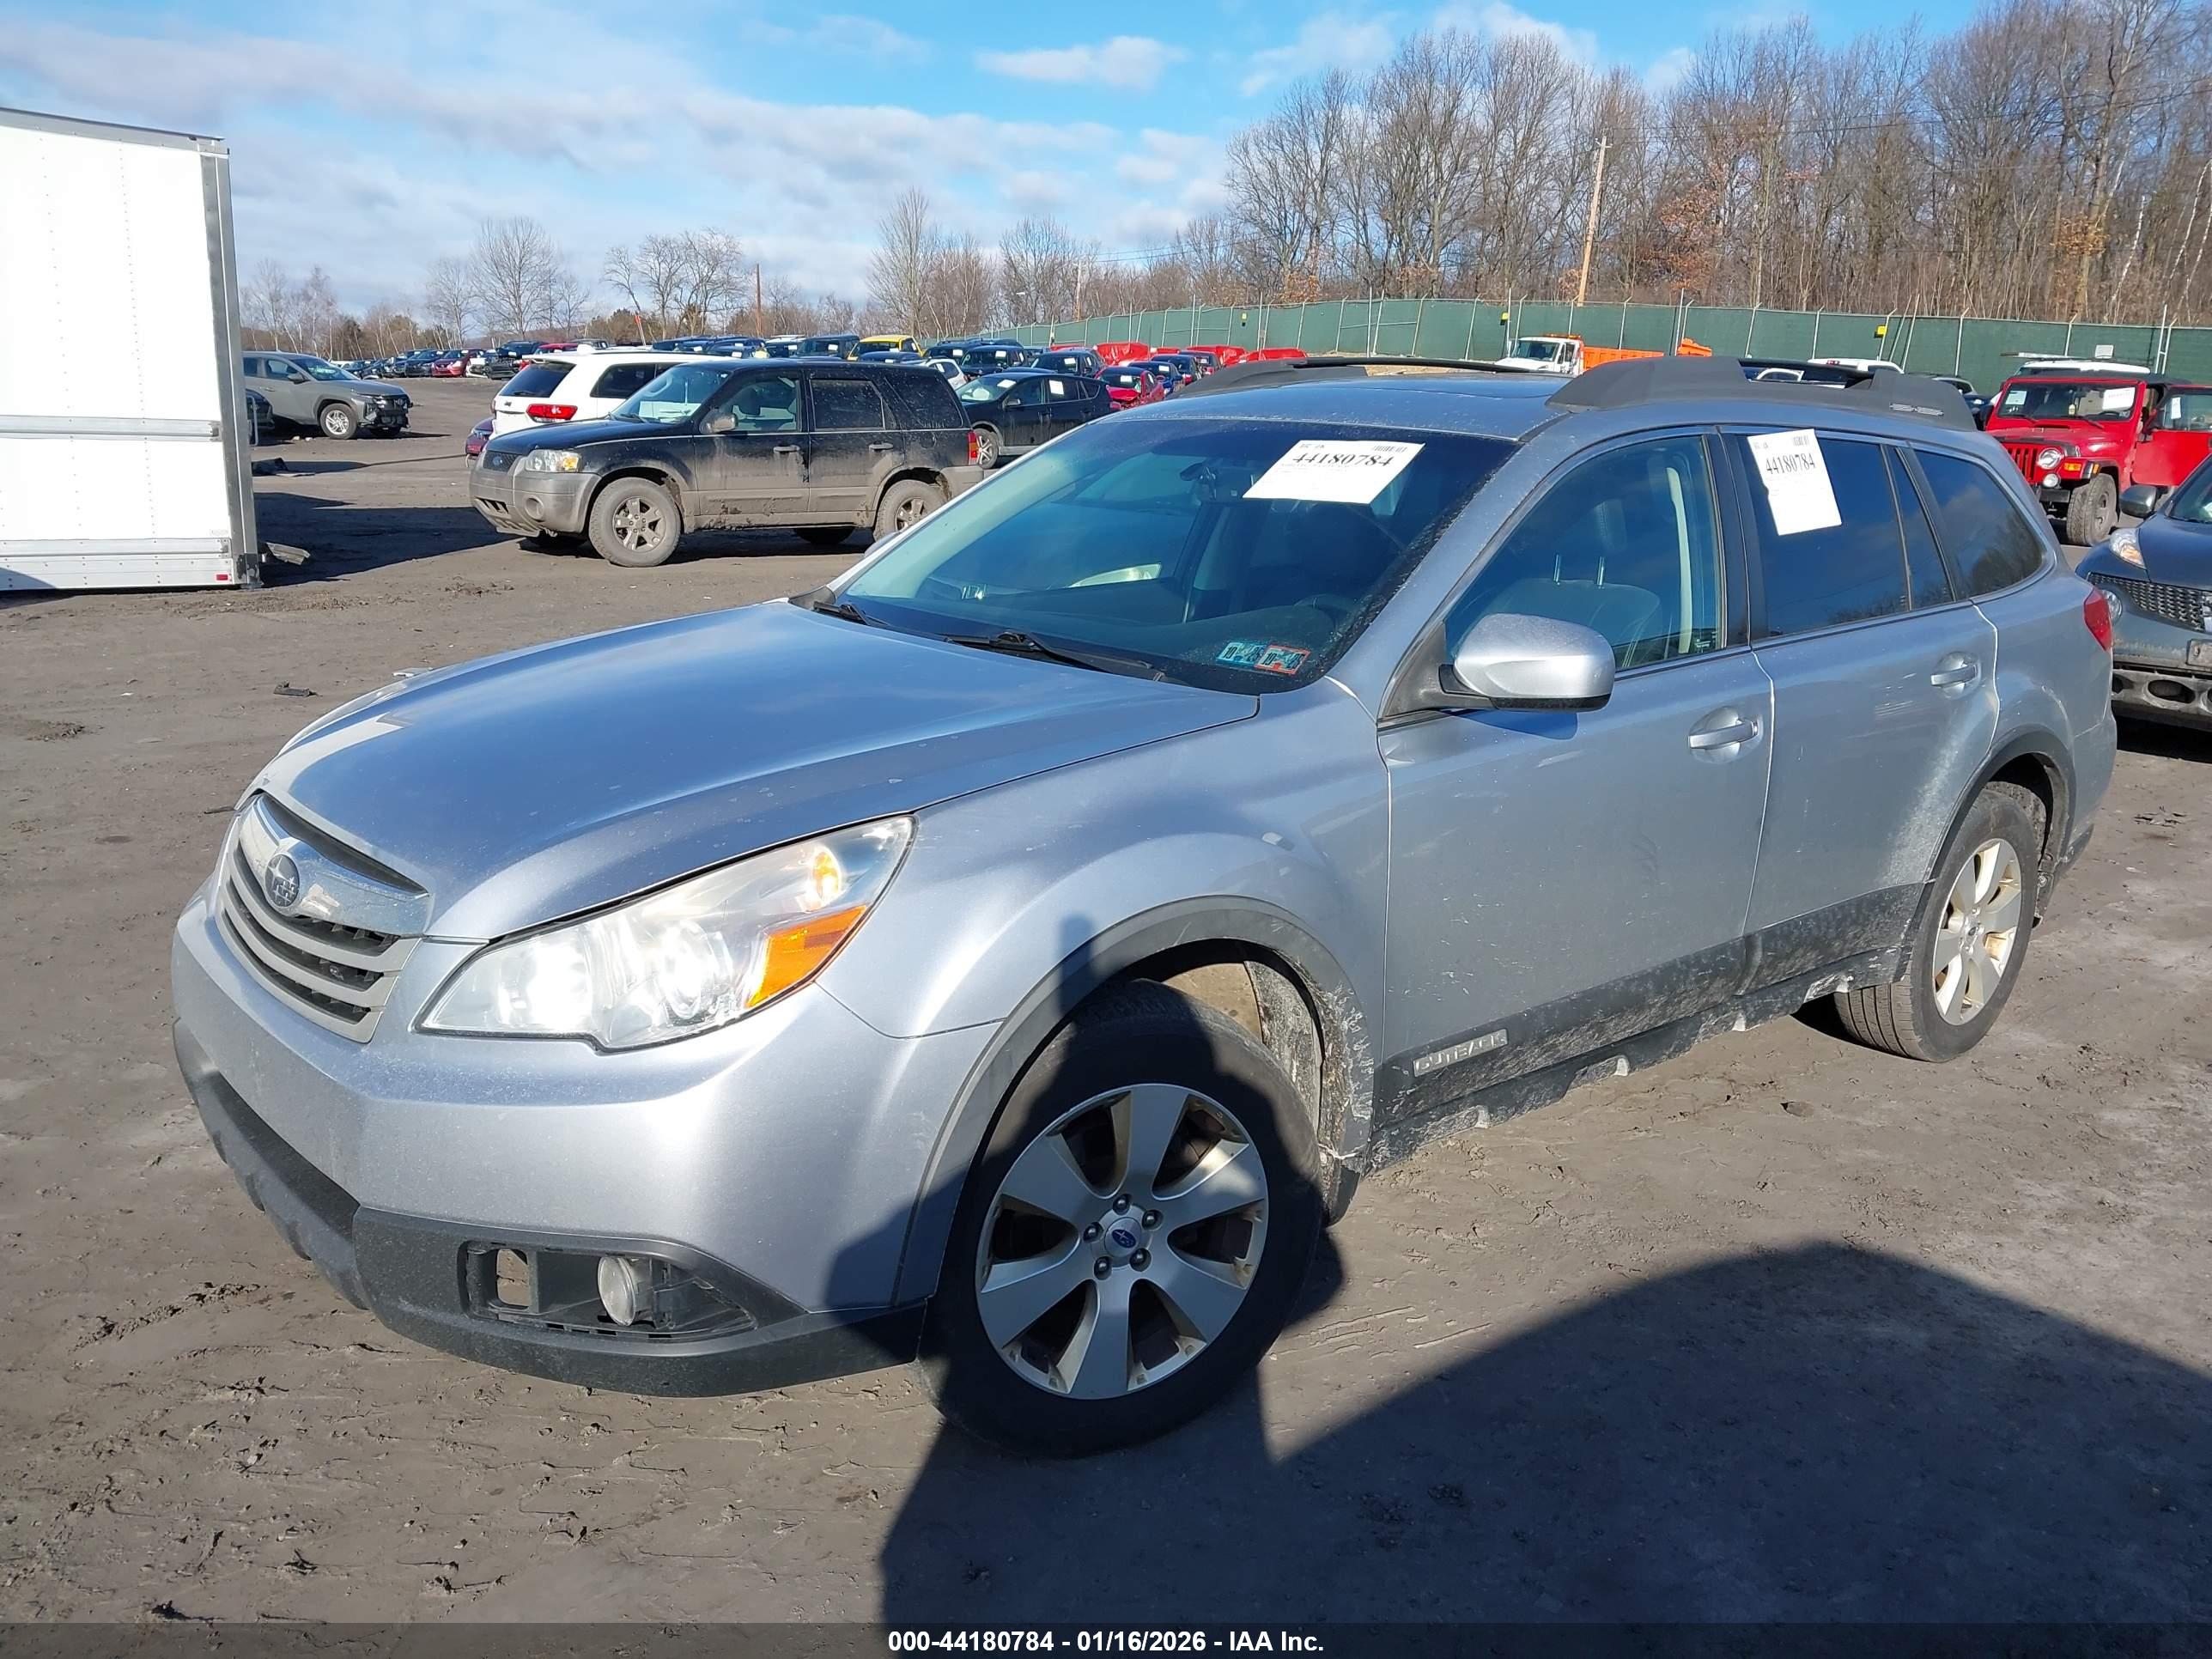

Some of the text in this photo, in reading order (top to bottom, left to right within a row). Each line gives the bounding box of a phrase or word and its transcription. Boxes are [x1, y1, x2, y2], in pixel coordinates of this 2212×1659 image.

[1292, 453, 1395, 467] 44180784
[1765, 453, 1816, 475] 44180784
[1415, 1033, 1506, 1073] OUTBACK
